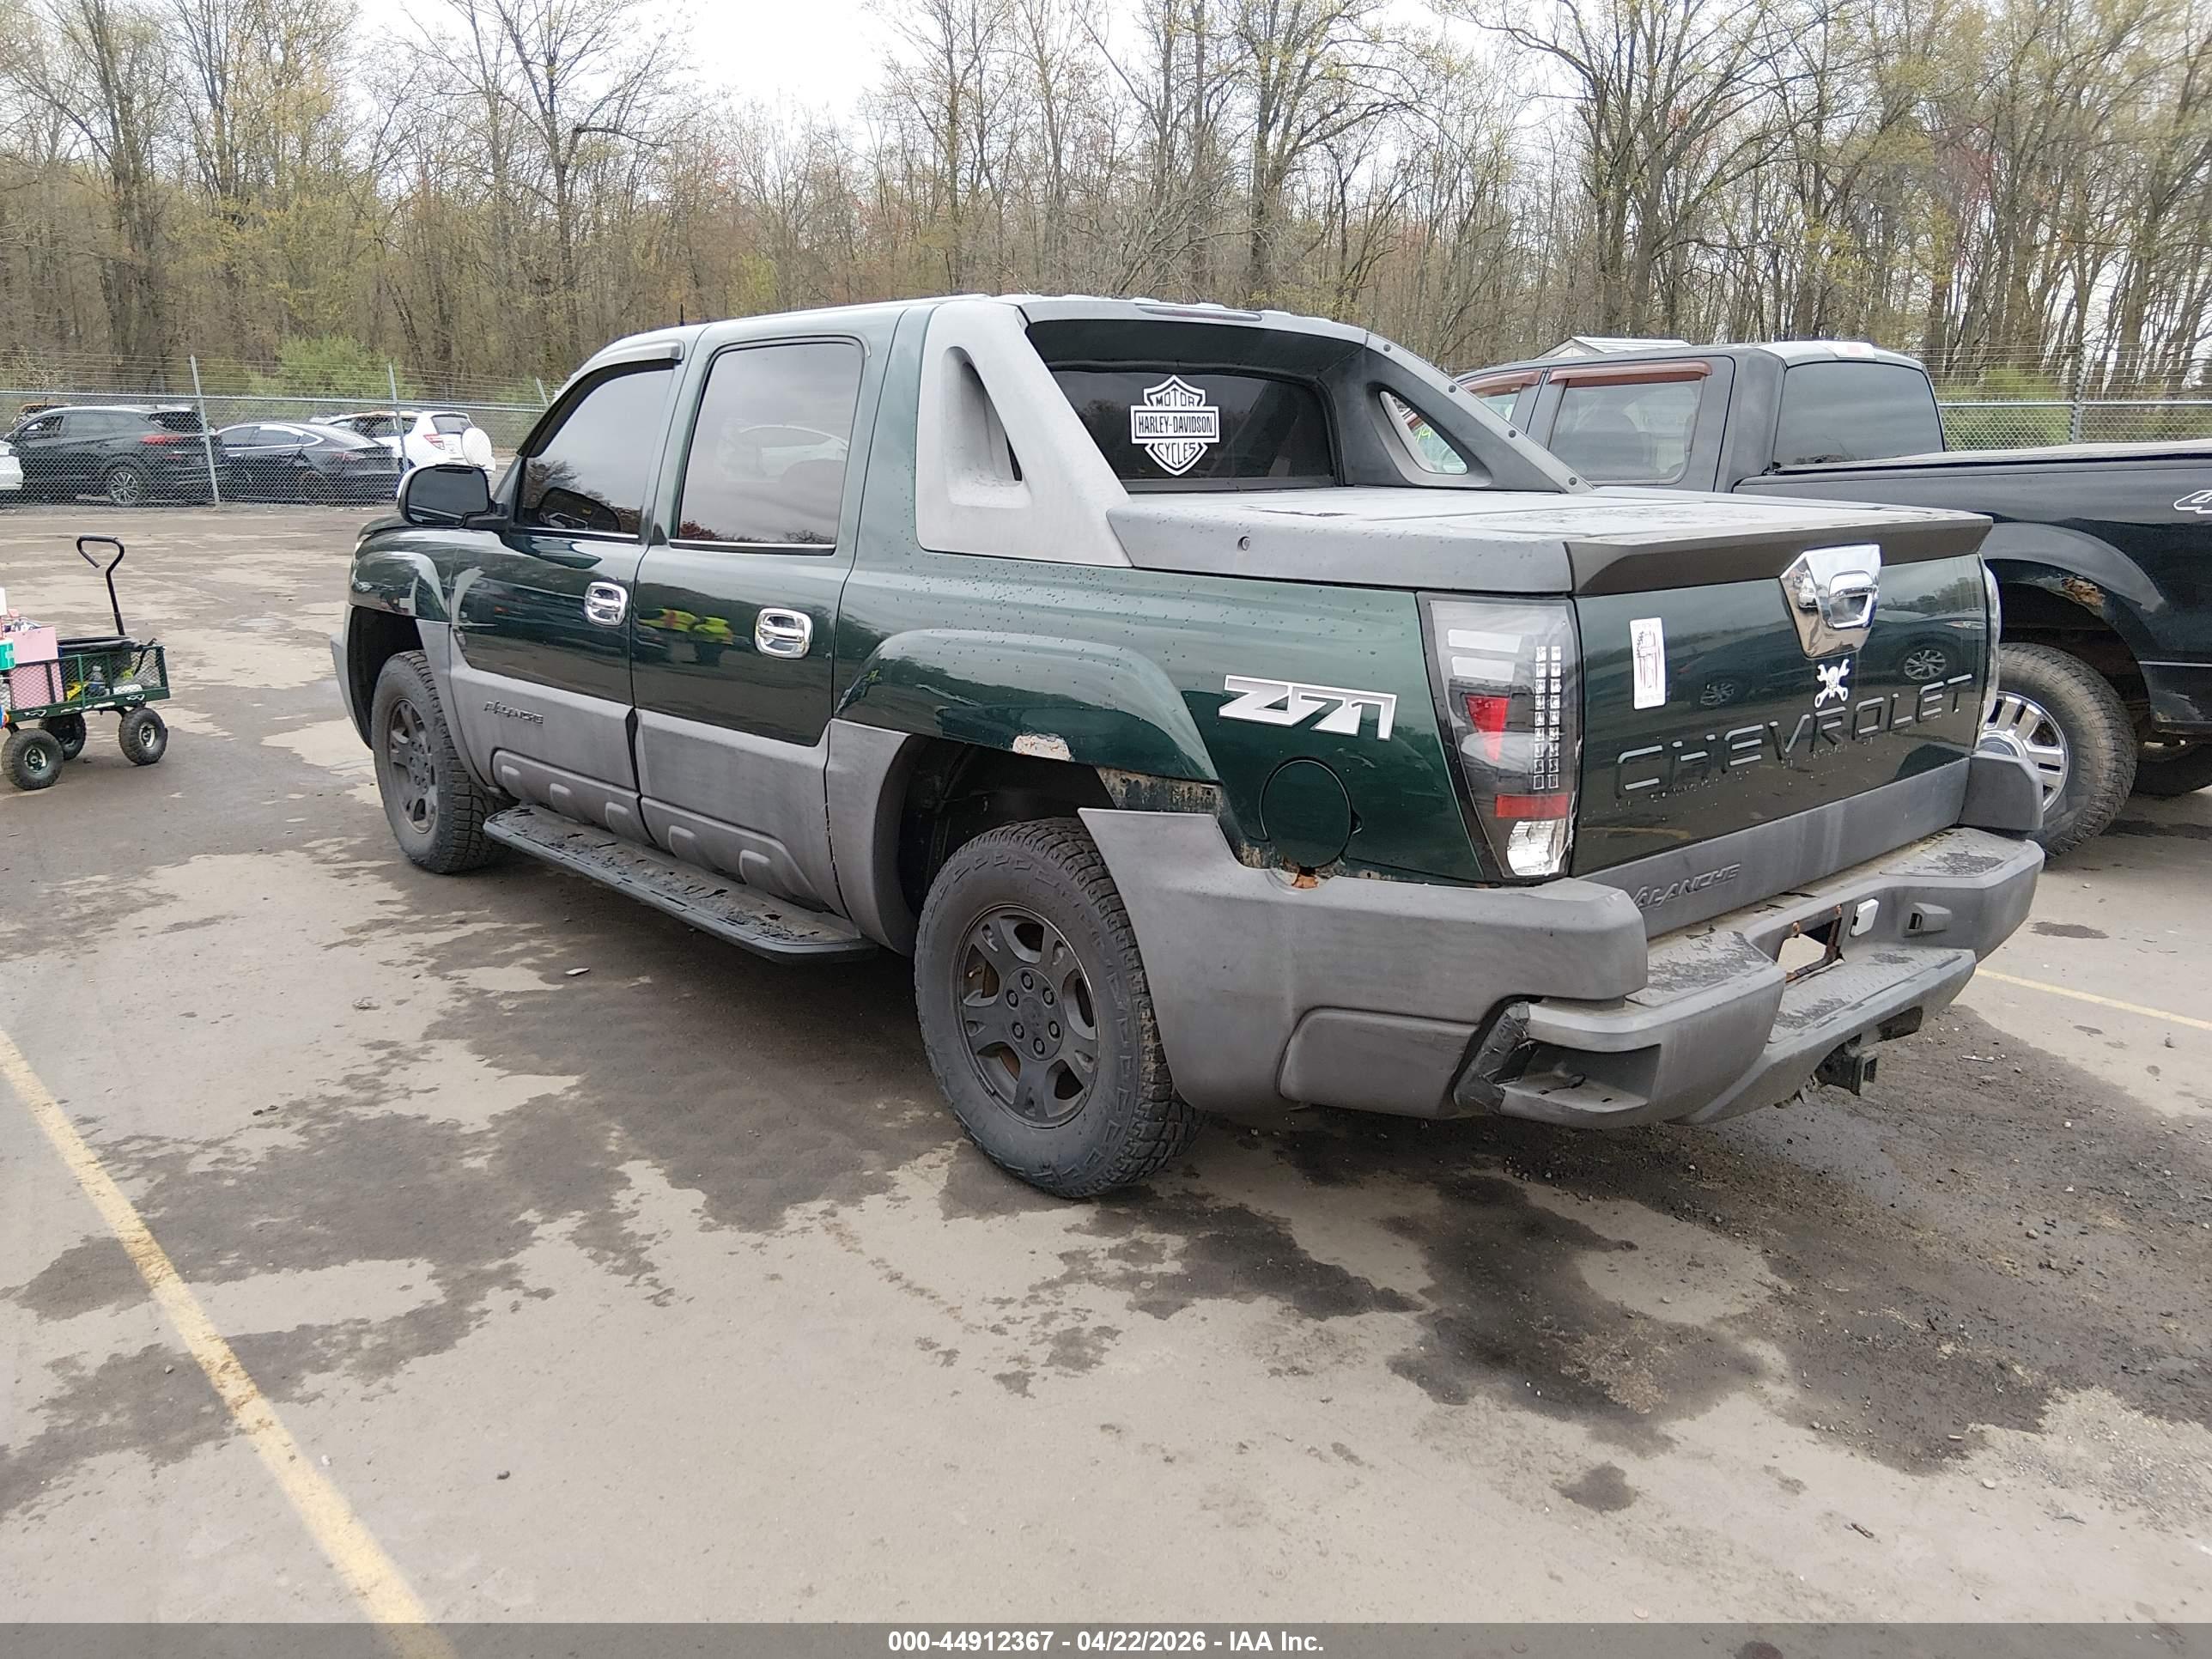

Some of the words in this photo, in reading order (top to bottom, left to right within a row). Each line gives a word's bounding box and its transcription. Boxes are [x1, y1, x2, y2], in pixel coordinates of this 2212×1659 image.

[1155, 387, 1195, 407] MOTOR
[1139, 416, 1212, 434] HARLEY-DAVIDSON
[1157, 442, 1196, 465] CYCLES
[1218, 674, 1398, 742] Z71
[1613, 674, 1972, 799] CHEVROLET
